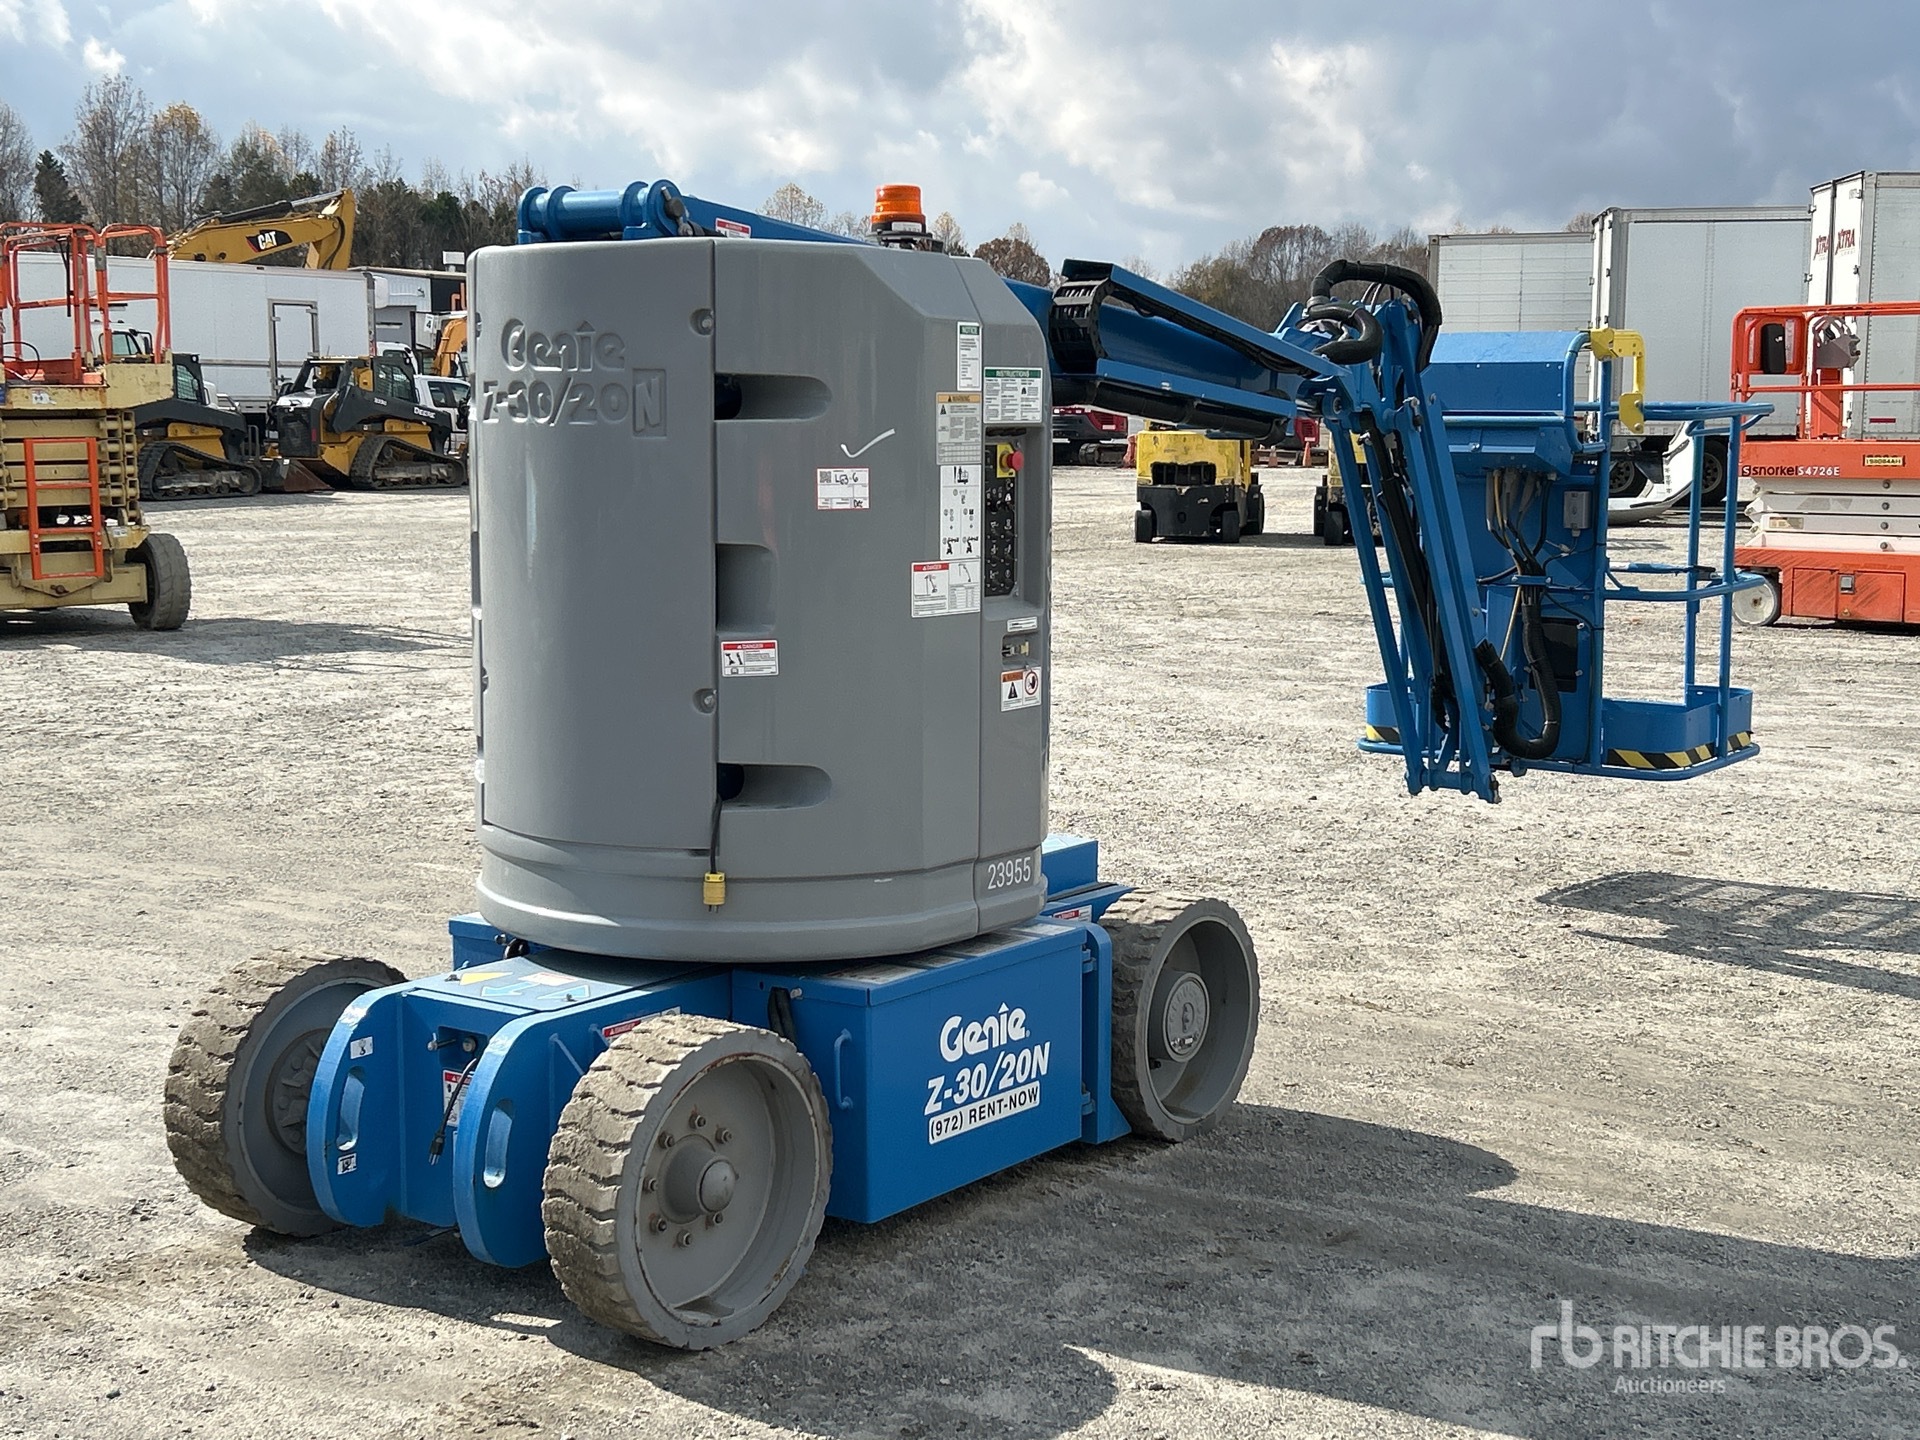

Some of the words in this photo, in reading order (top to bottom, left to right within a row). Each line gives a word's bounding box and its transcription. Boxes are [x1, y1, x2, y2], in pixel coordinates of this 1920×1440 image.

[258, 231, 277, 250] CAT
[1835, 229, 1856, 255] XTRA
[501, 317, 626, 372] Genie
[413, 406, 436, 419] DEERE
[1752, 465, 1799, 476] snorkel
[1798, 466, 1841, 476] S4726E
[987, 857, 1031, 890] 23955
[939, 1002, 1027, 1063] Genie
[924, 1041, 1051, 1116] Z-30/20N
[930, 1110, 964, 1140] (972)
[968, 1085, 1039, 1125] RENT-NOW
